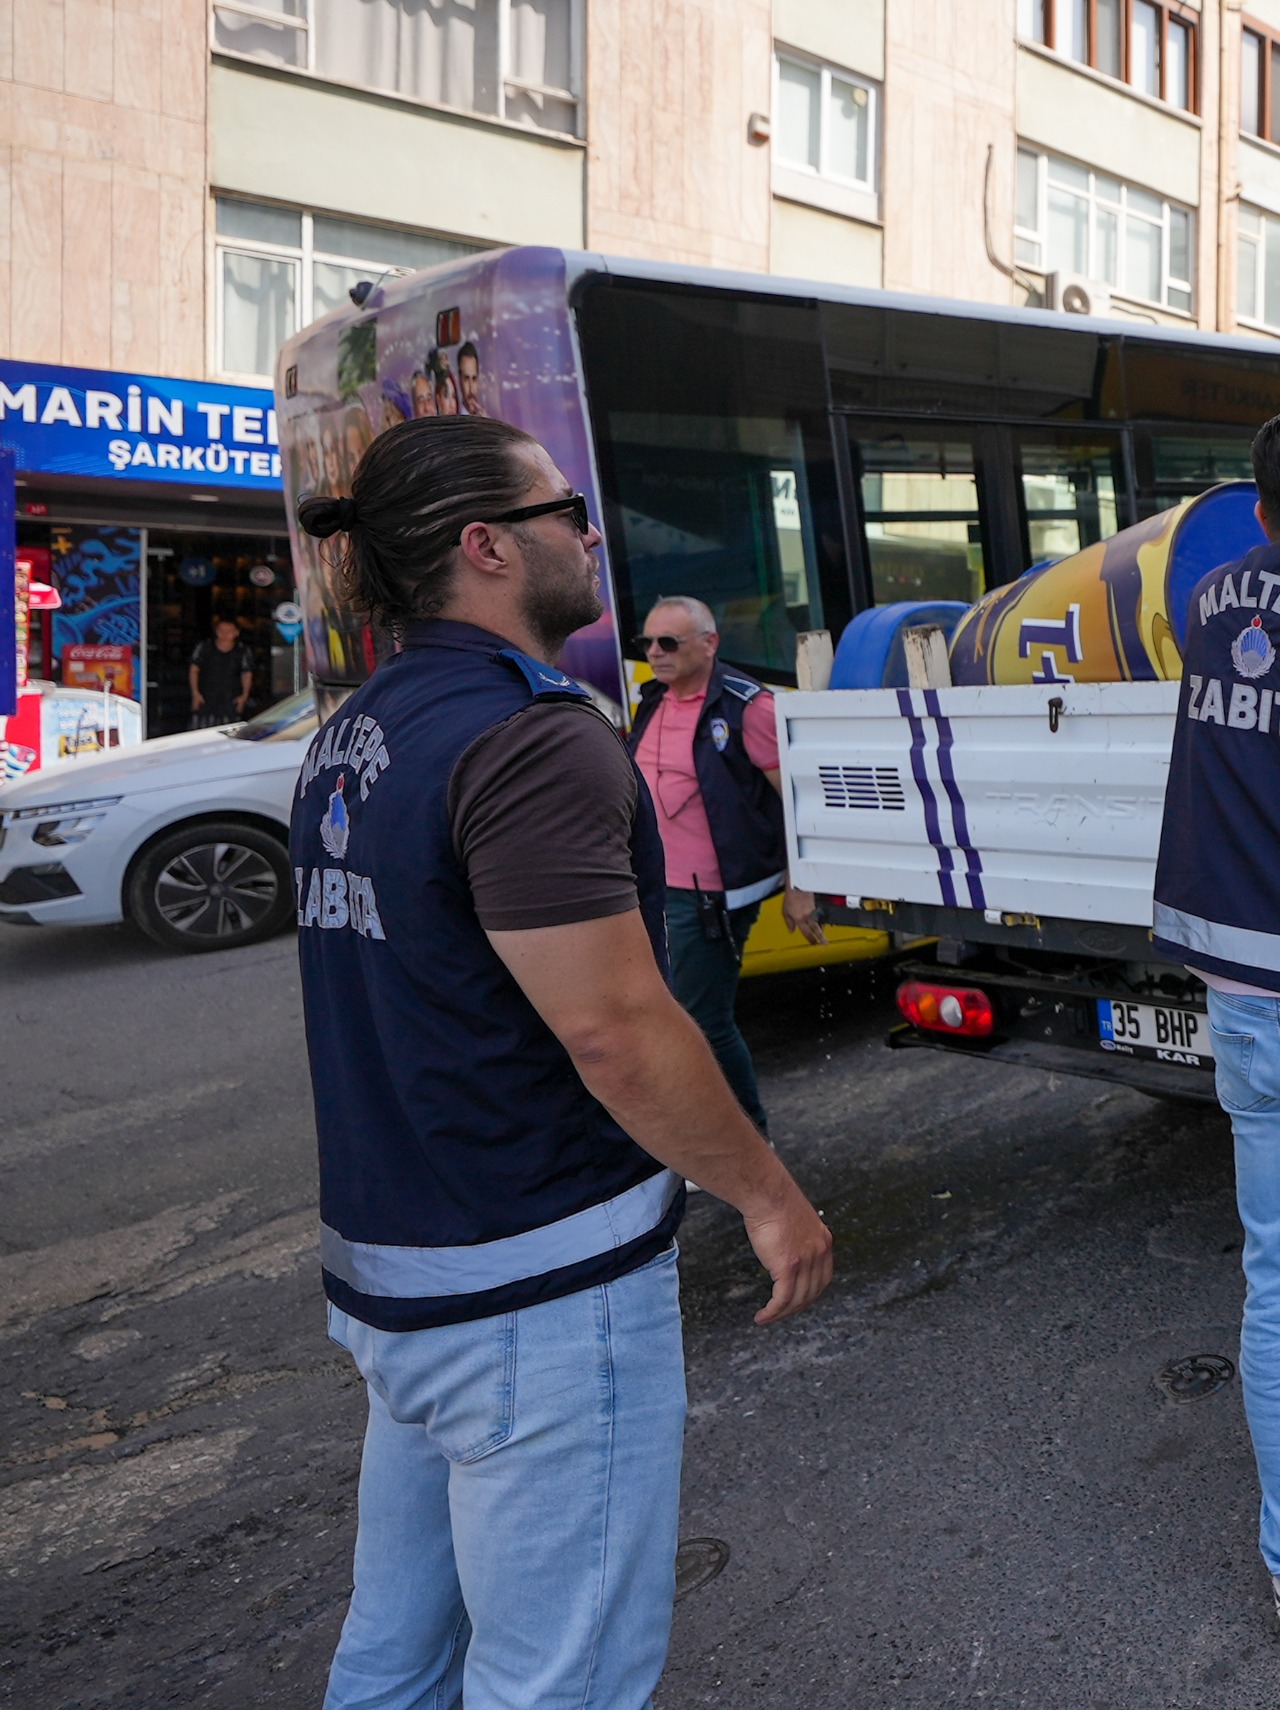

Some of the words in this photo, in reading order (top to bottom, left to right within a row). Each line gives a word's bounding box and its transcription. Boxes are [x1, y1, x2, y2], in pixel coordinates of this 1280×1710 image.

[300, 713, 391, 801] MALTEPE
[1101, 1020, 1112, 1032] TR
[1112, 1002, 1140, 1040] 35
[1154, 1008, 1198, 1049] BHP
[1156, 1049, 1200, 1066] KAR
